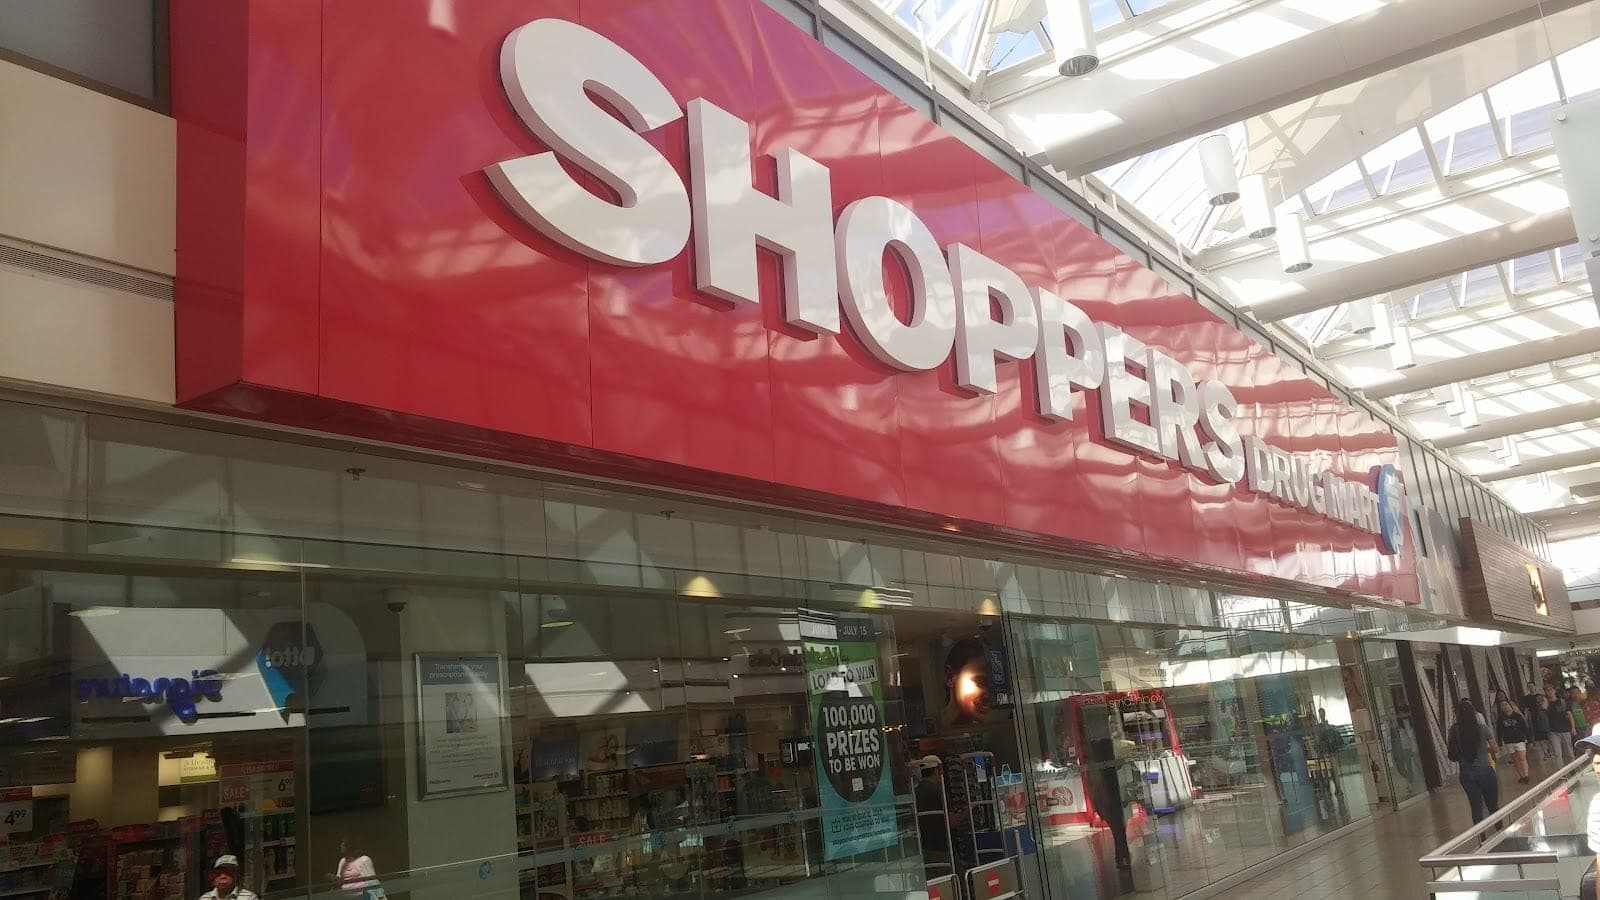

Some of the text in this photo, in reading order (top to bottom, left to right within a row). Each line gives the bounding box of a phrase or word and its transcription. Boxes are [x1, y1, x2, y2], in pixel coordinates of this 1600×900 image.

[484, 17, 1245, 484] SHOPPERS
[1245, 435, 1382, 534] DRUG MART
[843, 624, 858, 636] JULY
[860, 625, 867, 636] 15
[855, 664, 876, 681] WIN
[823, 703, 876, 729] 100,000
[826, 728, 880, 757] PRIZES
[829, 754, 881, 774] TO BE WON
[223, 786, 246, 801] SALE
